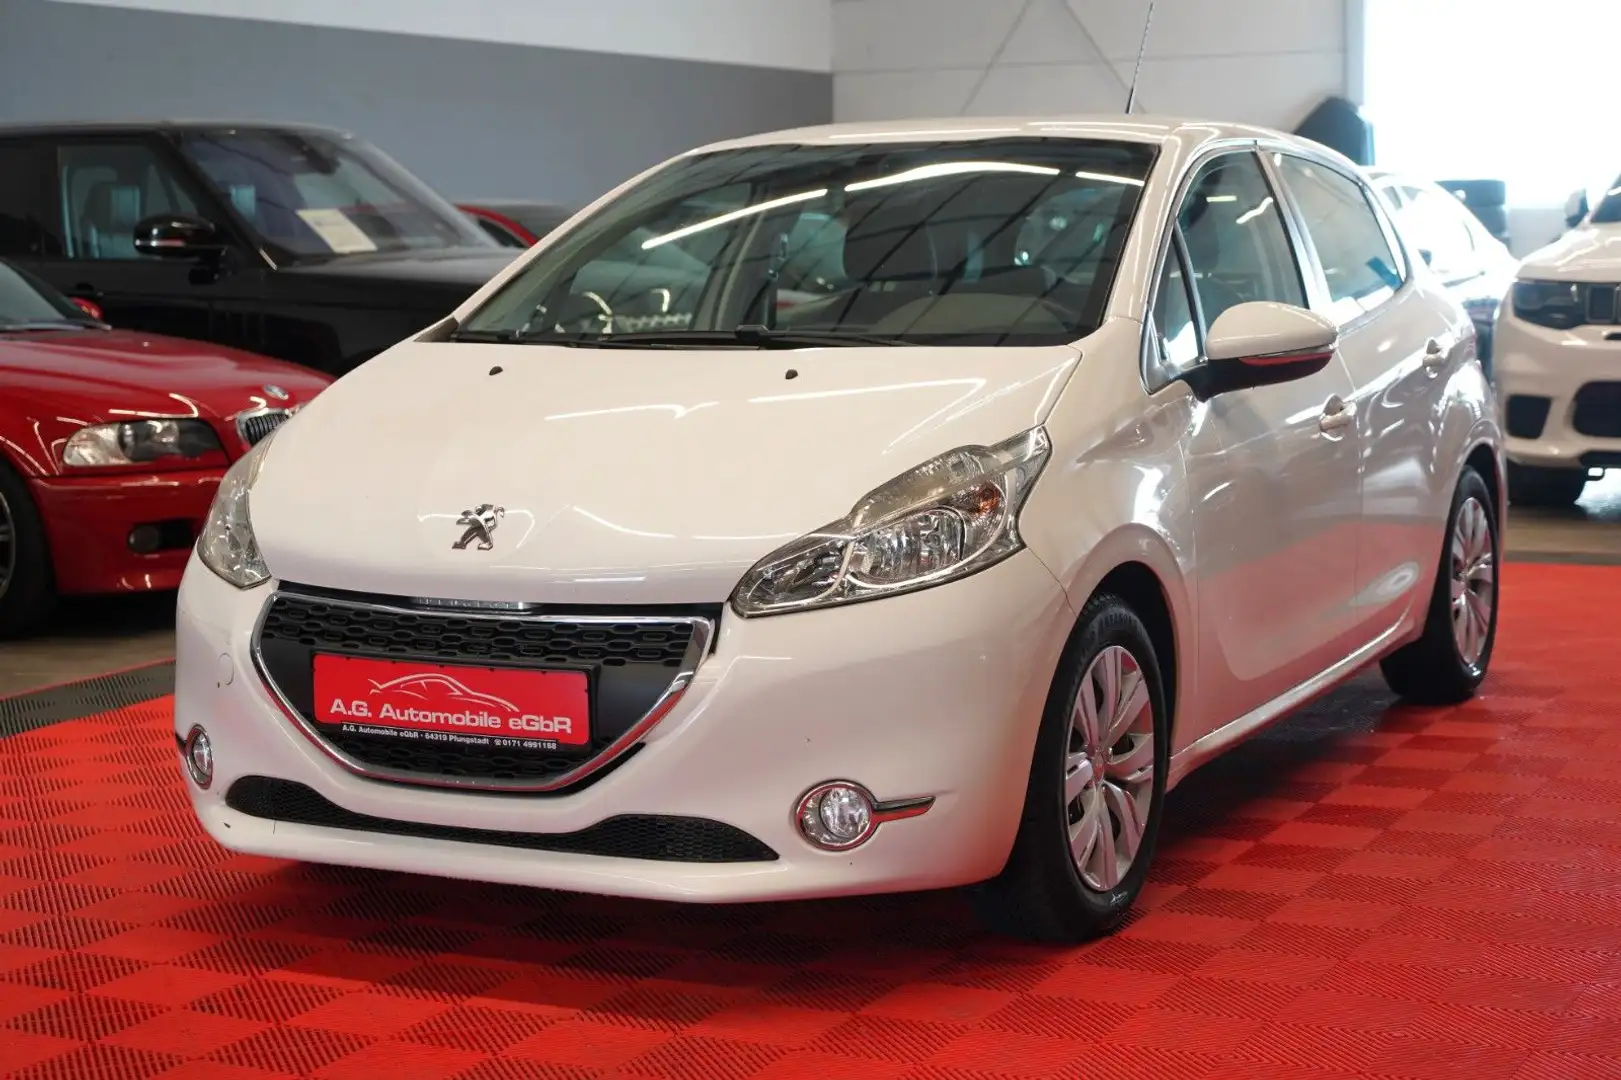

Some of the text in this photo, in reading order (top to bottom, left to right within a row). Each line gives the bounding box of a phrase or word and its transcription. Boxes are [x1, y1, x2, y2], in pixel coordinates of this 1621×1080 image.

[330, 698, 572, 734] A.G. Automobile eGbR
[342, 724, 357, 733] A.G.
[358, 726, 398, 737] Automobile
[424, 732, 448, 741] 64319
[448, 734, 490, 746] Pfungstadt
[502, 739, 521, 747] 0171
